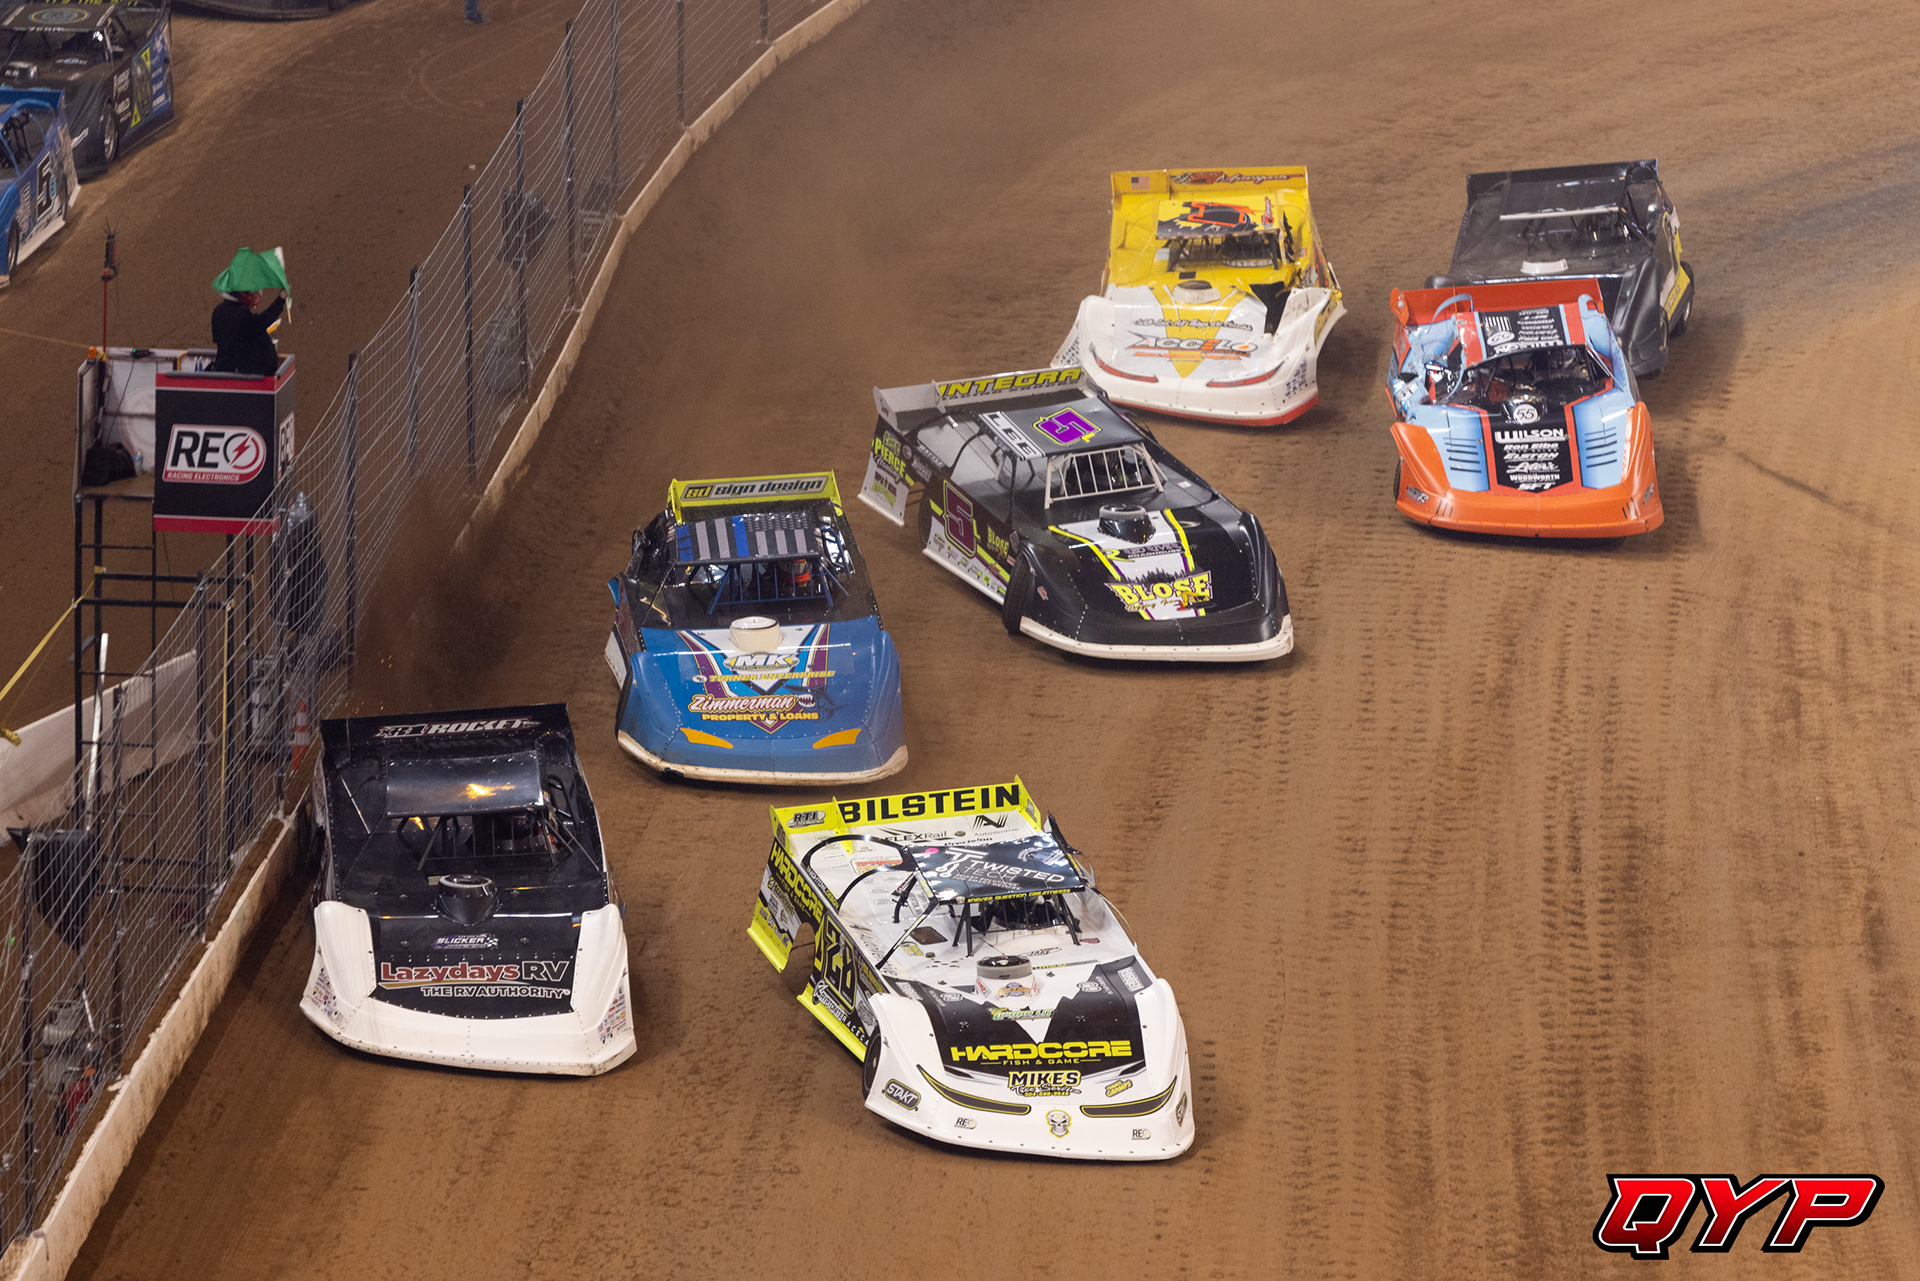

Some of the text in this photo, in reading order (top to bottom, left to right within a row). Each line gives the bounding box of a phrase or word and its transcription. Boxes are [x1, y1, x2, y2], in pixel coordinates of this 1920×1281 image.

[939, 368, 1082, 397] INTEGRA
[1516, 407, 1535, 420] 55
[988, 413, 1038, 456] LEE
[1036, 409, 1100, 446] 5
[1494, 428, 1564, 444] WILSON
[874, 437, 906, 478] PIERCE
[167, 472, 240, 482] RACING ELECTRONICS
[714, 484, 757, 496] sign
[758, 480, 824, 493] design
[944, 481, 975, 556] 5
[986, 524, 1009, 559] BLOSE
[1109, 573, 1212, 606] BLOSE
[734, 654, 791, 666] MK
[709, 674, 758, 683] TURNER
[759, 670, 837, 681] ENTERPRISE
[690, 695, 796, 712] Zimmerman
[701, 712, 820, 721] PROPERTY & LOANS
[427, 718, 531, 735] ROCKET
[838, 784, 1020, 824] BILSTEIN
[963, 866, 1017, 882] TECH
[970, 859, 1065, 883] TWISTED
[770, 841, 824, 924] HARDCORE
[381, 961, 570, 982] Lazydays RV
[421, 986, 453, 997] THE
[950, 1040, 1133, 1062] HARDCORE
[1010, 1071, 1080, 1086] MIKES
